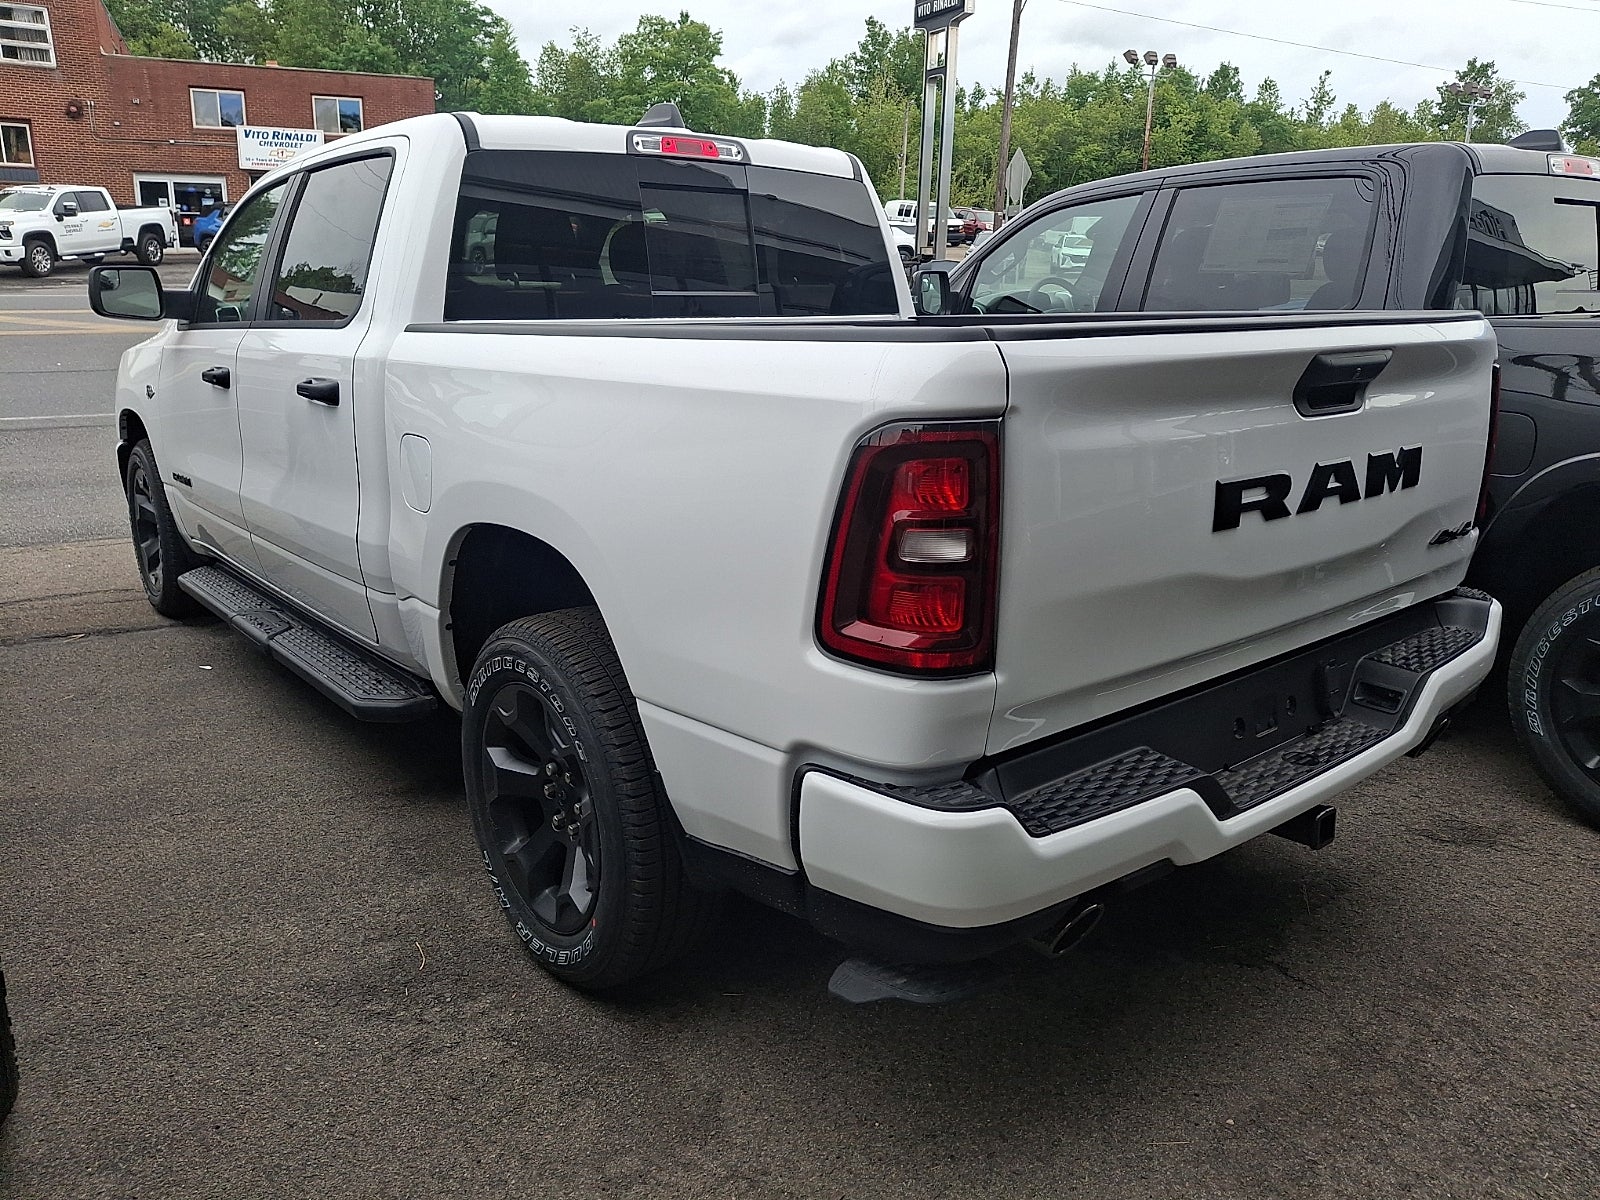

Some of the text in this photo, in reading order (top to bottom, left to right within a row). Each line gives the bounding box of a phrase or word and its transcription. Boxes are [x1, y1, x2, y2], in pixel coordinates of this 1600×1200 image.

[918, 2, 931, 17] VITO
[244, 129, 317, 142] VITO RINALDI
[259, 140, 303, 149] CHEVROLET
[1212, 443, 1423, 532] RAM
[468, 655, 588, 764] BRIDGESTONE
[515, 921, 594, 966] DUELER
